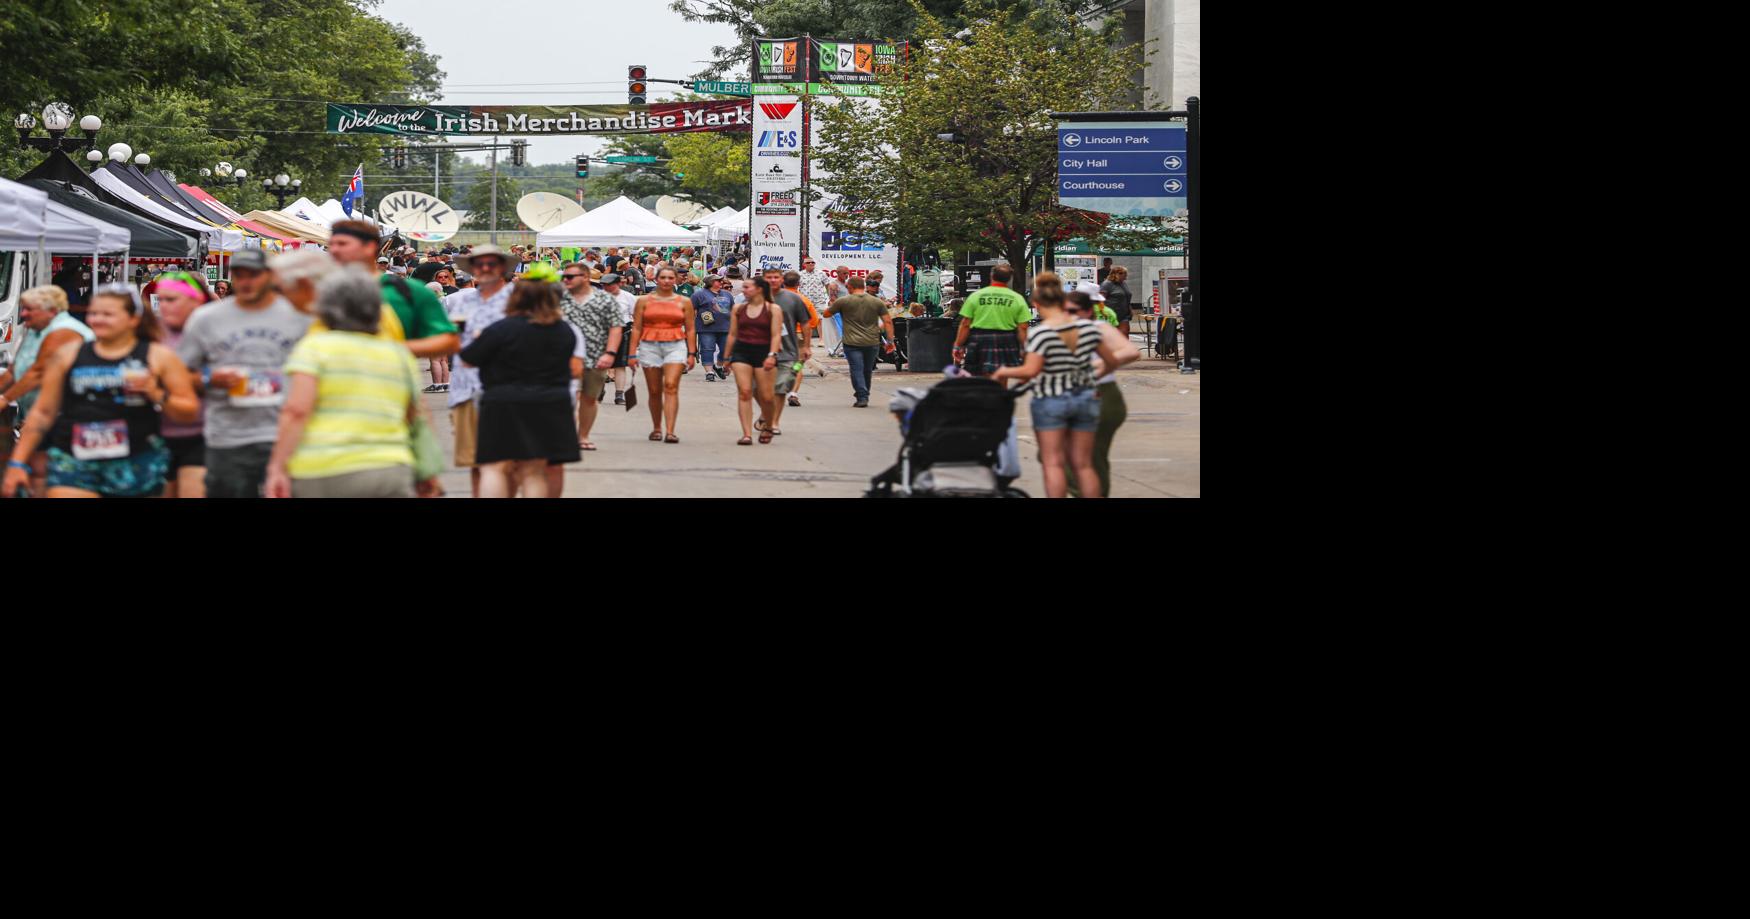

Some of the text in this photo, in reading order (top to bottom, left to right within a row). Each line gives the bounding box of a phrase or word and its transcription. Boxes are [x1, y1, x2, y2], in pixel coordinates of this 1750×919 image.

[876, 45, 895, 55] IOWA
[338, 109, 426, 133] Welcome
[435, 106, 751, 132] Irish Merchandise Mark
[398, 123, 426, 131] to the
[777, 130, 797, 148] E&S
[1085, 136, 1149, 144] Lincoln Park
[1063, 159, 1107, 169] City Hall
[1063, 181, 1125, 189] Courthouse
[771, 192, 793, 200] FREED
[382, 193, 450, 225] KWWL
